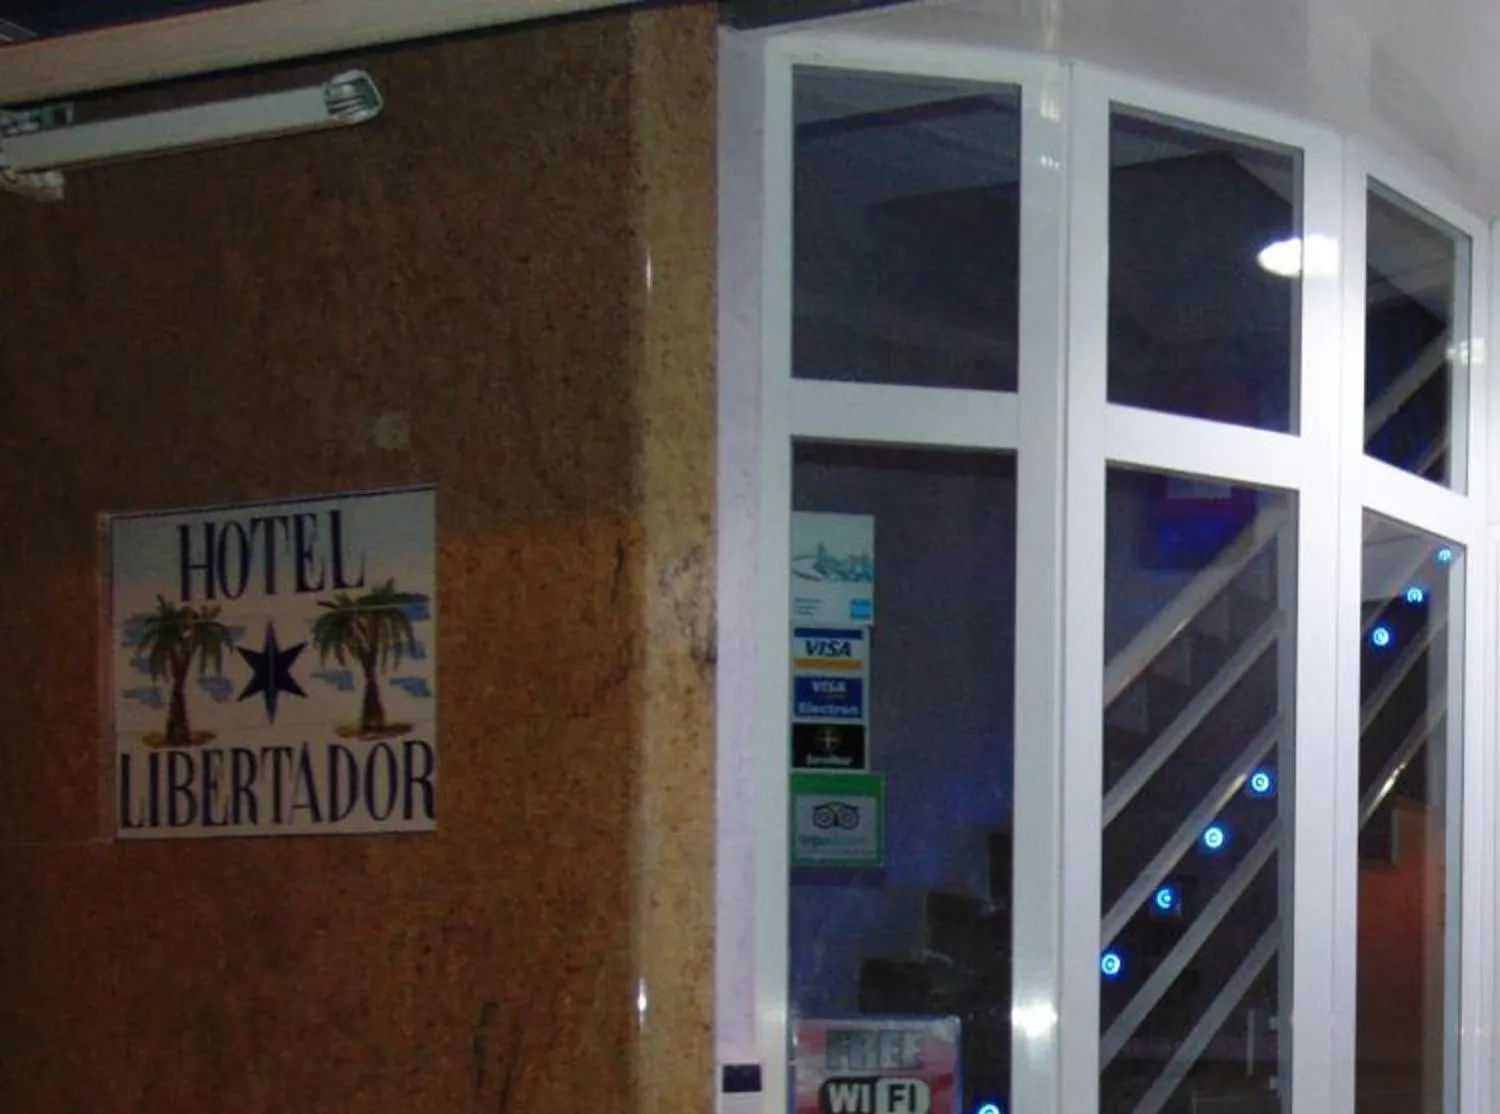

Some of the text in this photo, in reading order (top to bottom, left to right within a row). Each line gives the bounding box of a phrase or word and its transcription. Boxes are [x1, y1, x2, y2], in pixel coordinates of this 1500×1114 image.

[178, 509, 365, 601] HOTEL
[805, 640, 852, 657] VISA
[811, 680, 847, 693] VISA
[119, 740, 437, 830] LIBERTADOR
